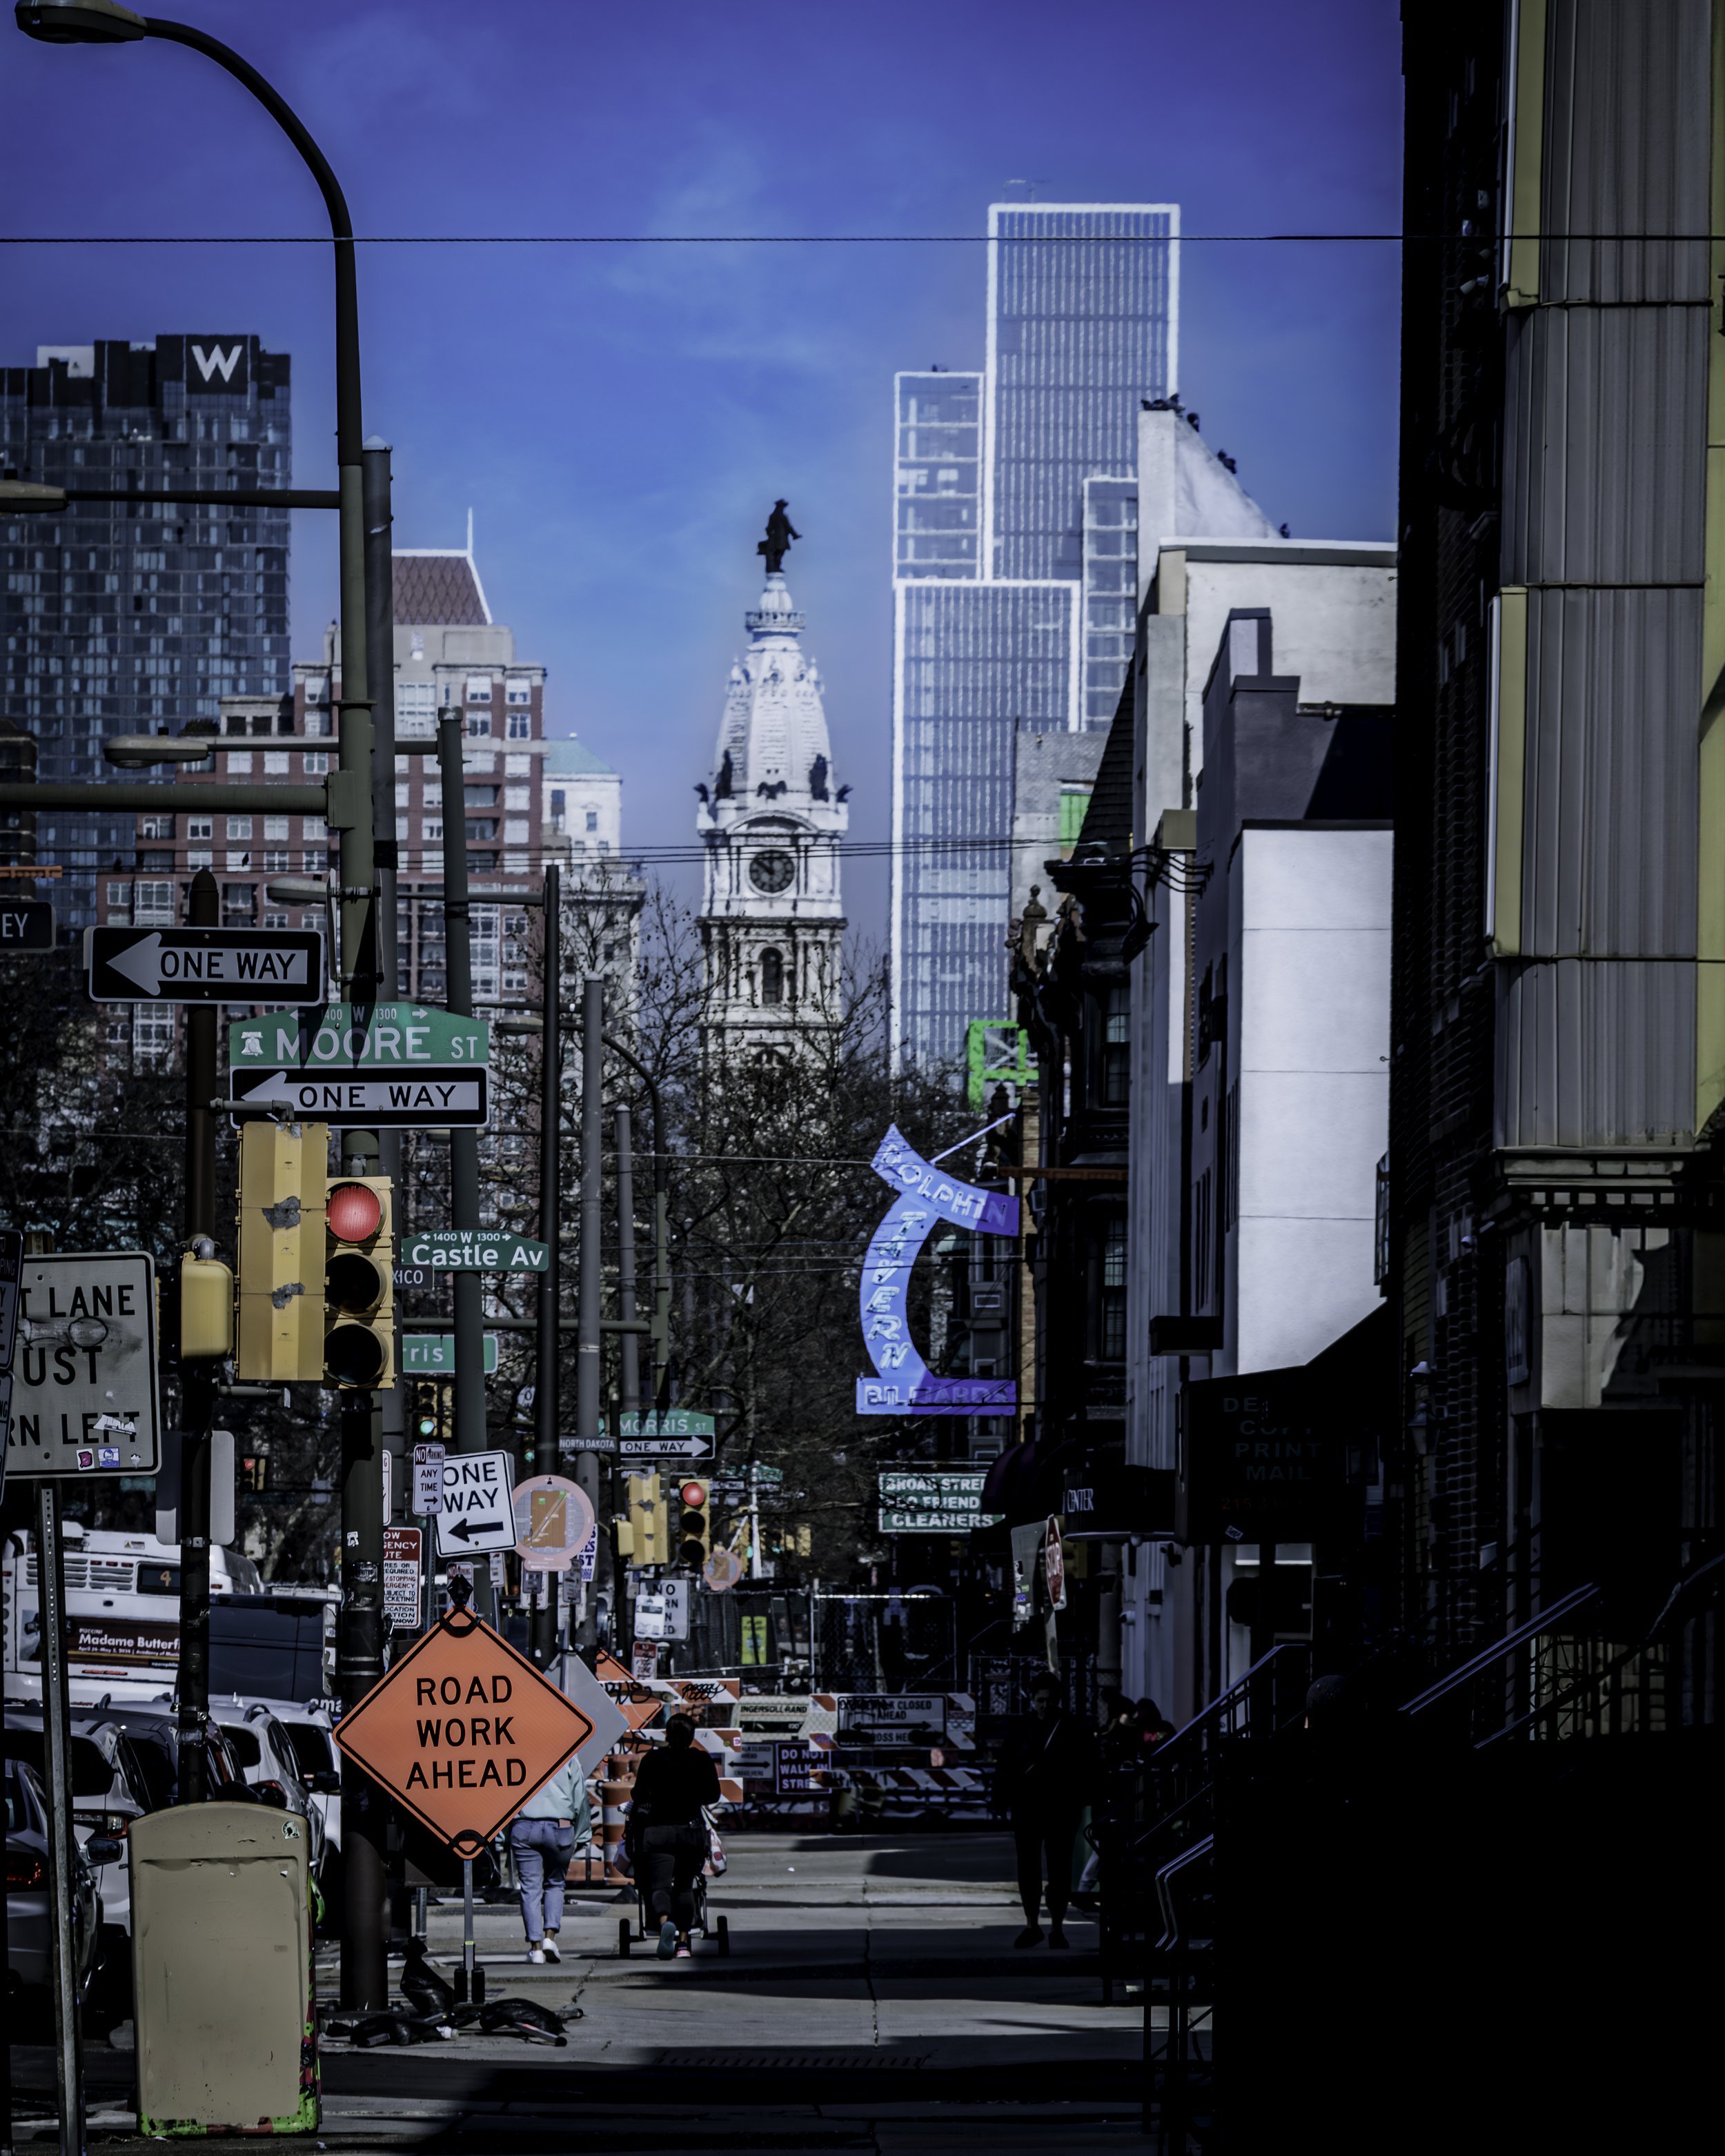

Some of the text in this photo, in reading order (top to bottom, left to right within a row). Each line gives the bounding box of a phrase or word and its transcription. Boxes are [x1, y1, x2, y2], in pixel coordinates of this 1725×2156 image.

[191, 344, 242, 382] W
[1, 913, 29, 938] EY
[160, 951, 296, 980] ONE WAY
[321, 1006, 397, 1022] 1400 W 1300
[276, 1027, 477, 1060] MOORE ST
[299, 1085, 456, 1108] ONE WAY
[883, 1145, 1009, 1227] DOLPHIN
[433, 1232, 500, 1243] 1400 W 1300
[412, 1244, 543, 1266] Castle Av
[392, 1269, 424, 1285] XICO
[865, 1211, 927, 1370] TAVERN
[21, 1288, 31, 1318] T
[49, 1284, 135, 1318] LANE
[403, 1343, 444, 1362] ris
[23, 1345, 102, 1387] UST
[865, 1385, 1009, 1405] BILLIARDS
[61, 1412, 139, 1445] LEFT
[620, 1419, 706, 1433] MORRIS ST
[559, 1439, 615, 1449] NORTH DAKOTA
[625, 1442, 685, 1451] ONE WAY
[415, 1450, 425, 1462] NO
[421, 1469, 437, 1478] ANY
[443, 1461, 497, 1486] ONE
[420, 1483, 437, 1492] TIME
[941, 1478, 985, 1491] STRE
[443, 1487, 498, 1513] WAY
[923, 1496, 980, 1509] FRIEND
[891, 1513, 994, 1527] CLEANERS
[160, 1570, 172, 1586] 4
[653, 1584, 676, 1595] NO
[665, 1599, 678, 1608] RN
[665, 1612, 672, 1621] N
[79, 1633, 180, 1650] Madame Butterf
[416, 1675, 512, 1705] ROAD
[898, 1700, 931, 1710] CLOSED
[878, 1710, 907, 1720] AHEAD
[416, 1717, 515, 1747] WORK
[874, 1733, 909, 1742] ROSS HE
[781, 1749, 825, 1760] DO NOT
[406, 1759, 526, 1790] AHEAD
[780, 1763, 811, 1774] WALK
[782, 1779, 809, 1790] STRE
